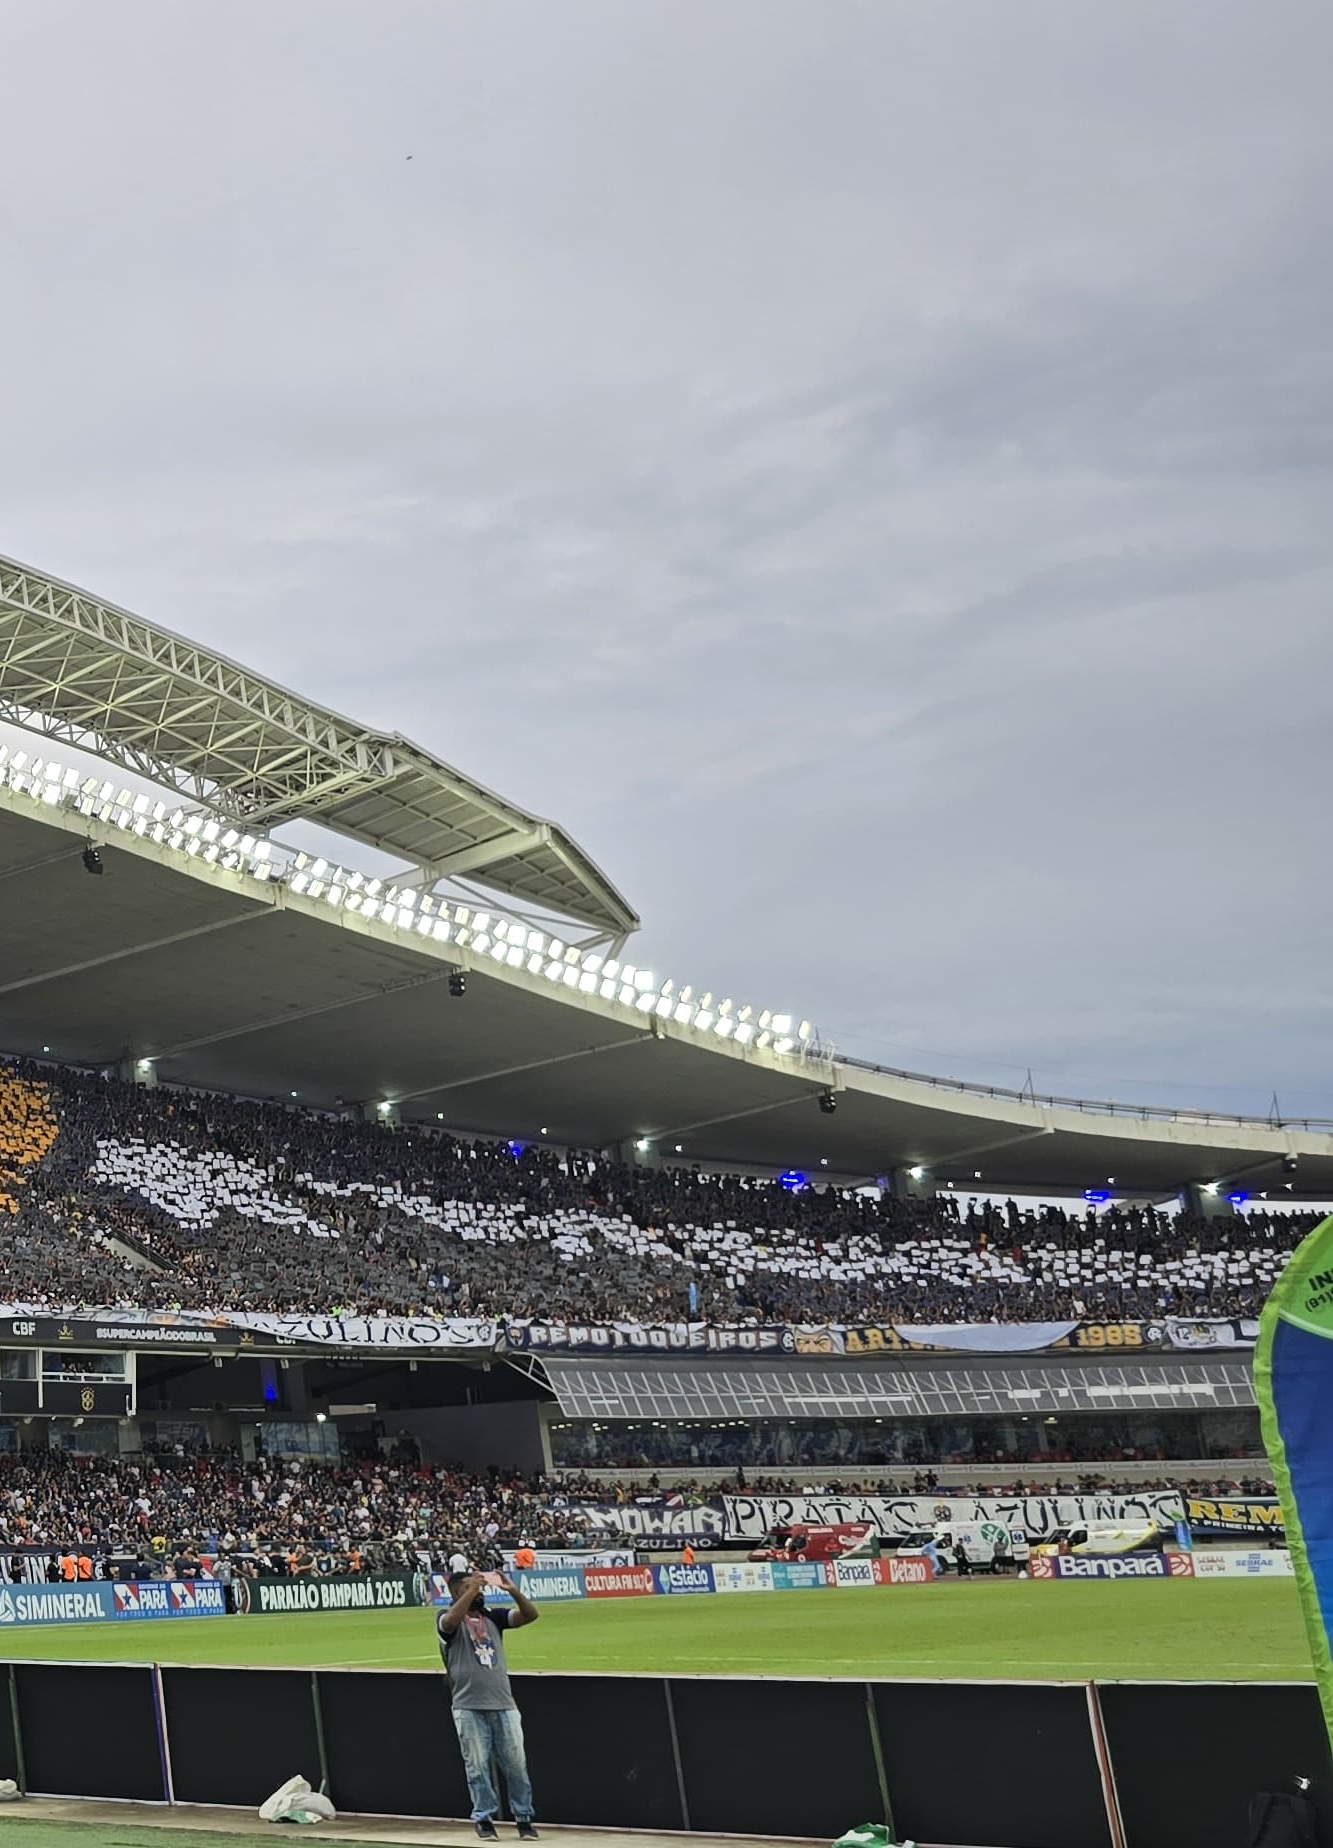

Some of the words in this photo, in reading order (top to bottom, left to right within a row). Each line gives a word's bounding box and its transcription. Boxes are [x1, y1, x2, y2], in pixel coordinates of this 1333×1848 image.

[12, 1321, 36, 1336] CBF
[1076, 1323, 1142, 1348] 1985
[1187, 1499, 1286, 1525] REM
[889, 1559, 927, 1583] Betano
[1057, 1546, 1163, 1577] Banpará
[530, 1575, 581, 1600] SIMINERAL
[585, 1574, 623, 1591] CULTURA
[669, 1565, 708, 1586] Estácio
[260, 1579, 318, 1611] PARAZÃO
[321, 1576, 374, 1608] BANPARÁ
[375, 1581, 406, 1606] 2025
[17, 1592, 106, 1621] SIMINERAL
